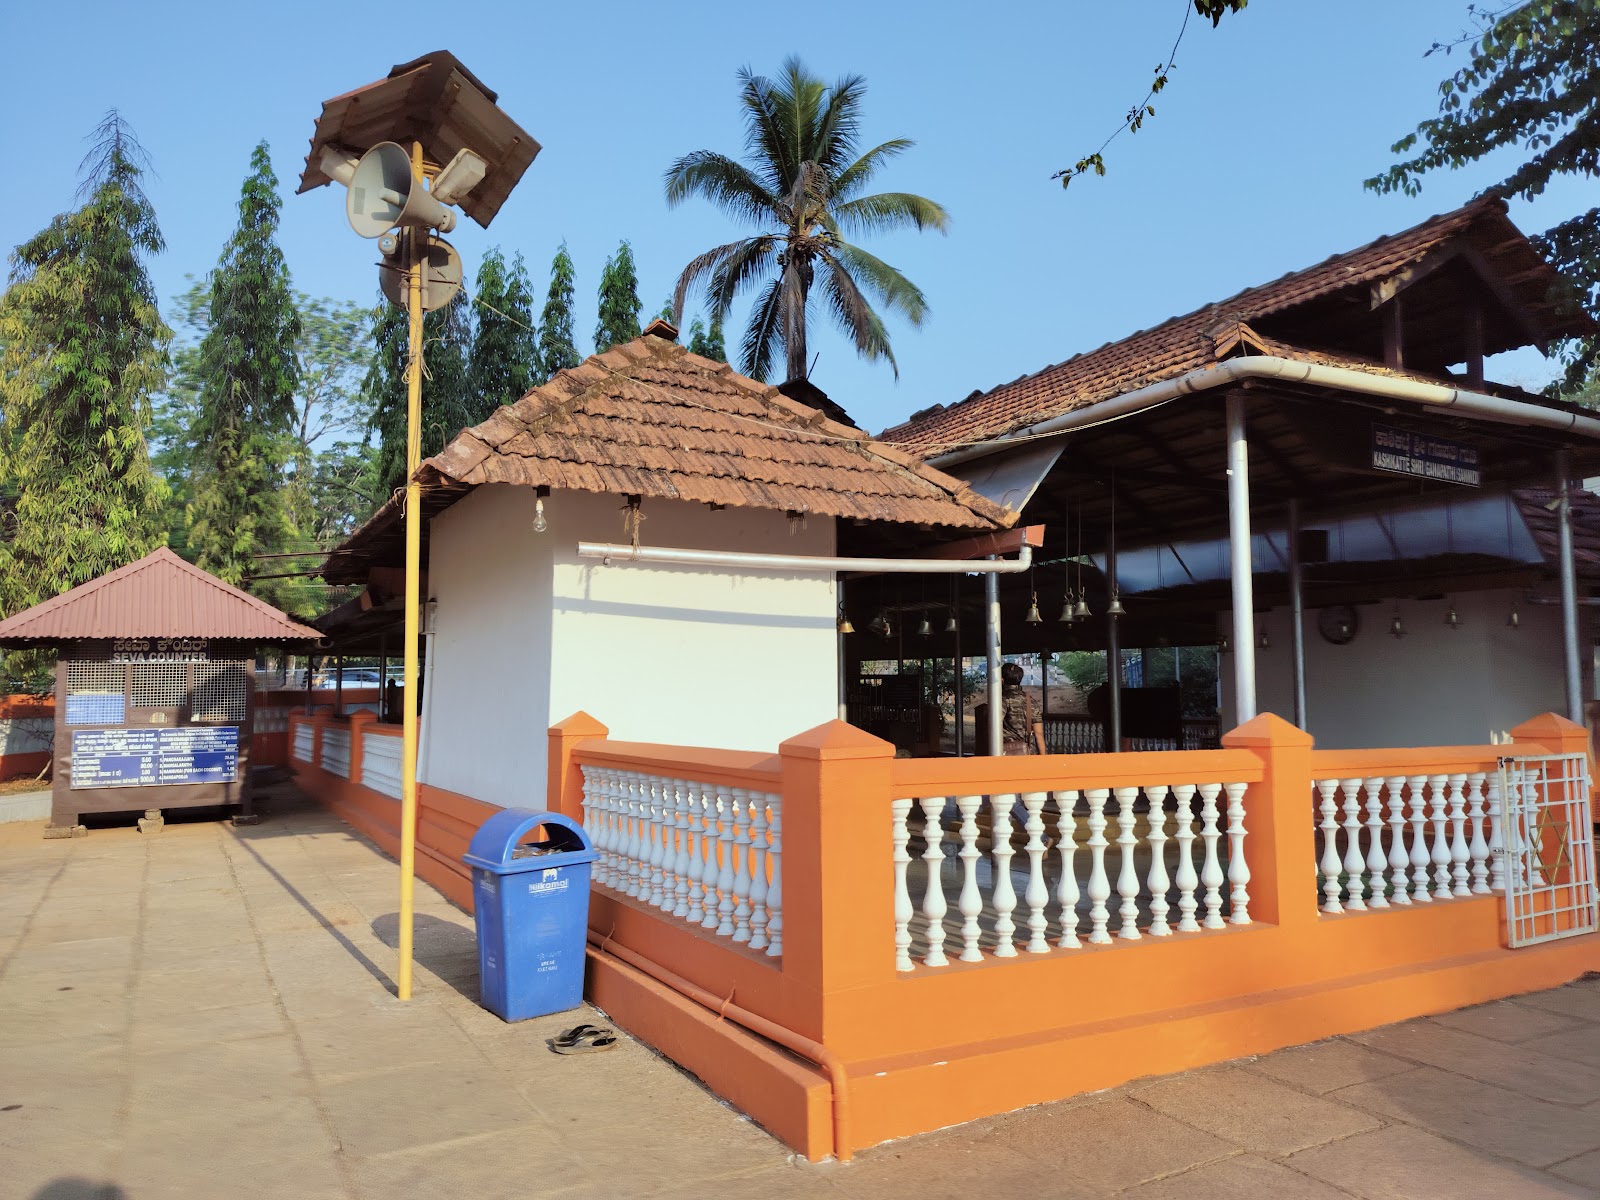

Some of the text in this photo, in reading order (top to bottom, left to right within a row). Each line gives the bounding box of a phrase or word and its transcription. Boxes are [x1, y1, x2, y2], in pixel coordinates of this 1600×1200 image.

[1373, 450, 1411, 473] KASHIKATTE
[1410, 457, 1424, 475] SHRI
[1425, 460, 1457, 481] GANAPATHI
[113, 637, 208, 652] ಸೇವಾ ಕೌಂಟರ್
[113, 652, 207, 662] SEVA COUNTER
[528, 878, 569, 892] Nilkamal
